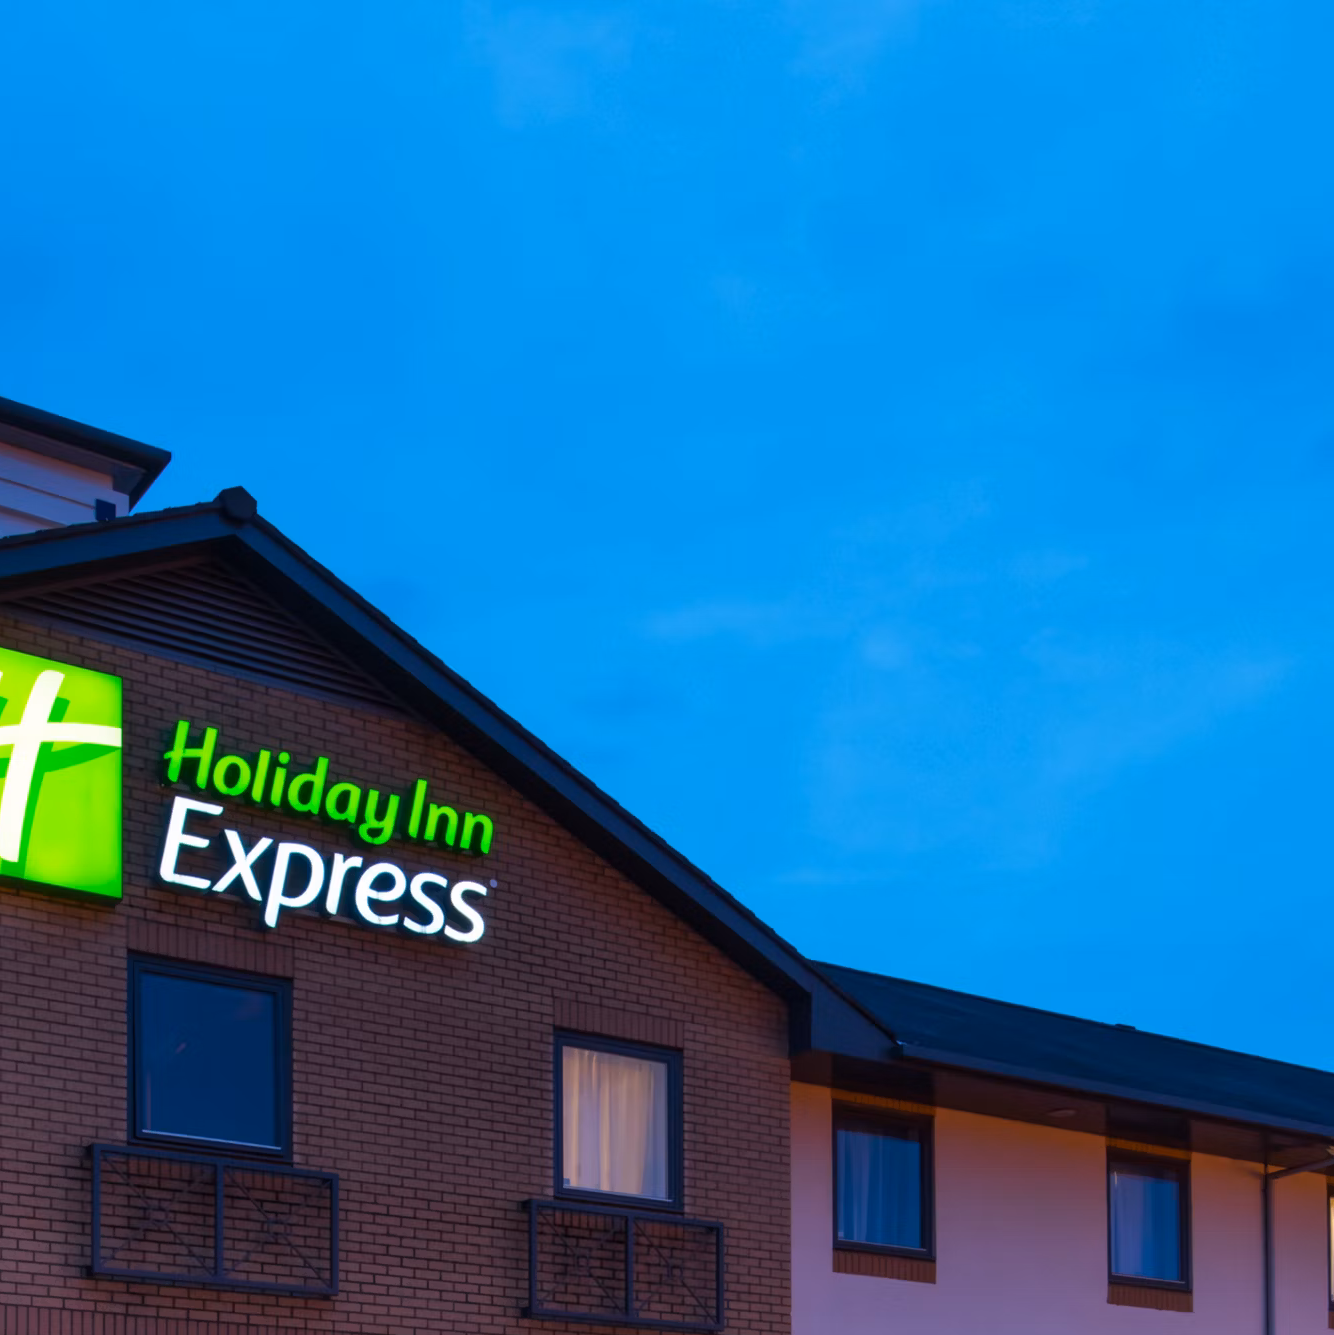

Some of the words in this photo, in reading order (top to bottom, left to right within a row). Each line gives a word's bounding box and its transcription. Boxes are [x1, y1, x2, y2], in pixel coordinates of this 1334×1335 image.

[163, 719, 401, 845] Holiday
[407, 778, 494, 855] Inn
[159, 795, 489, 943] Express
